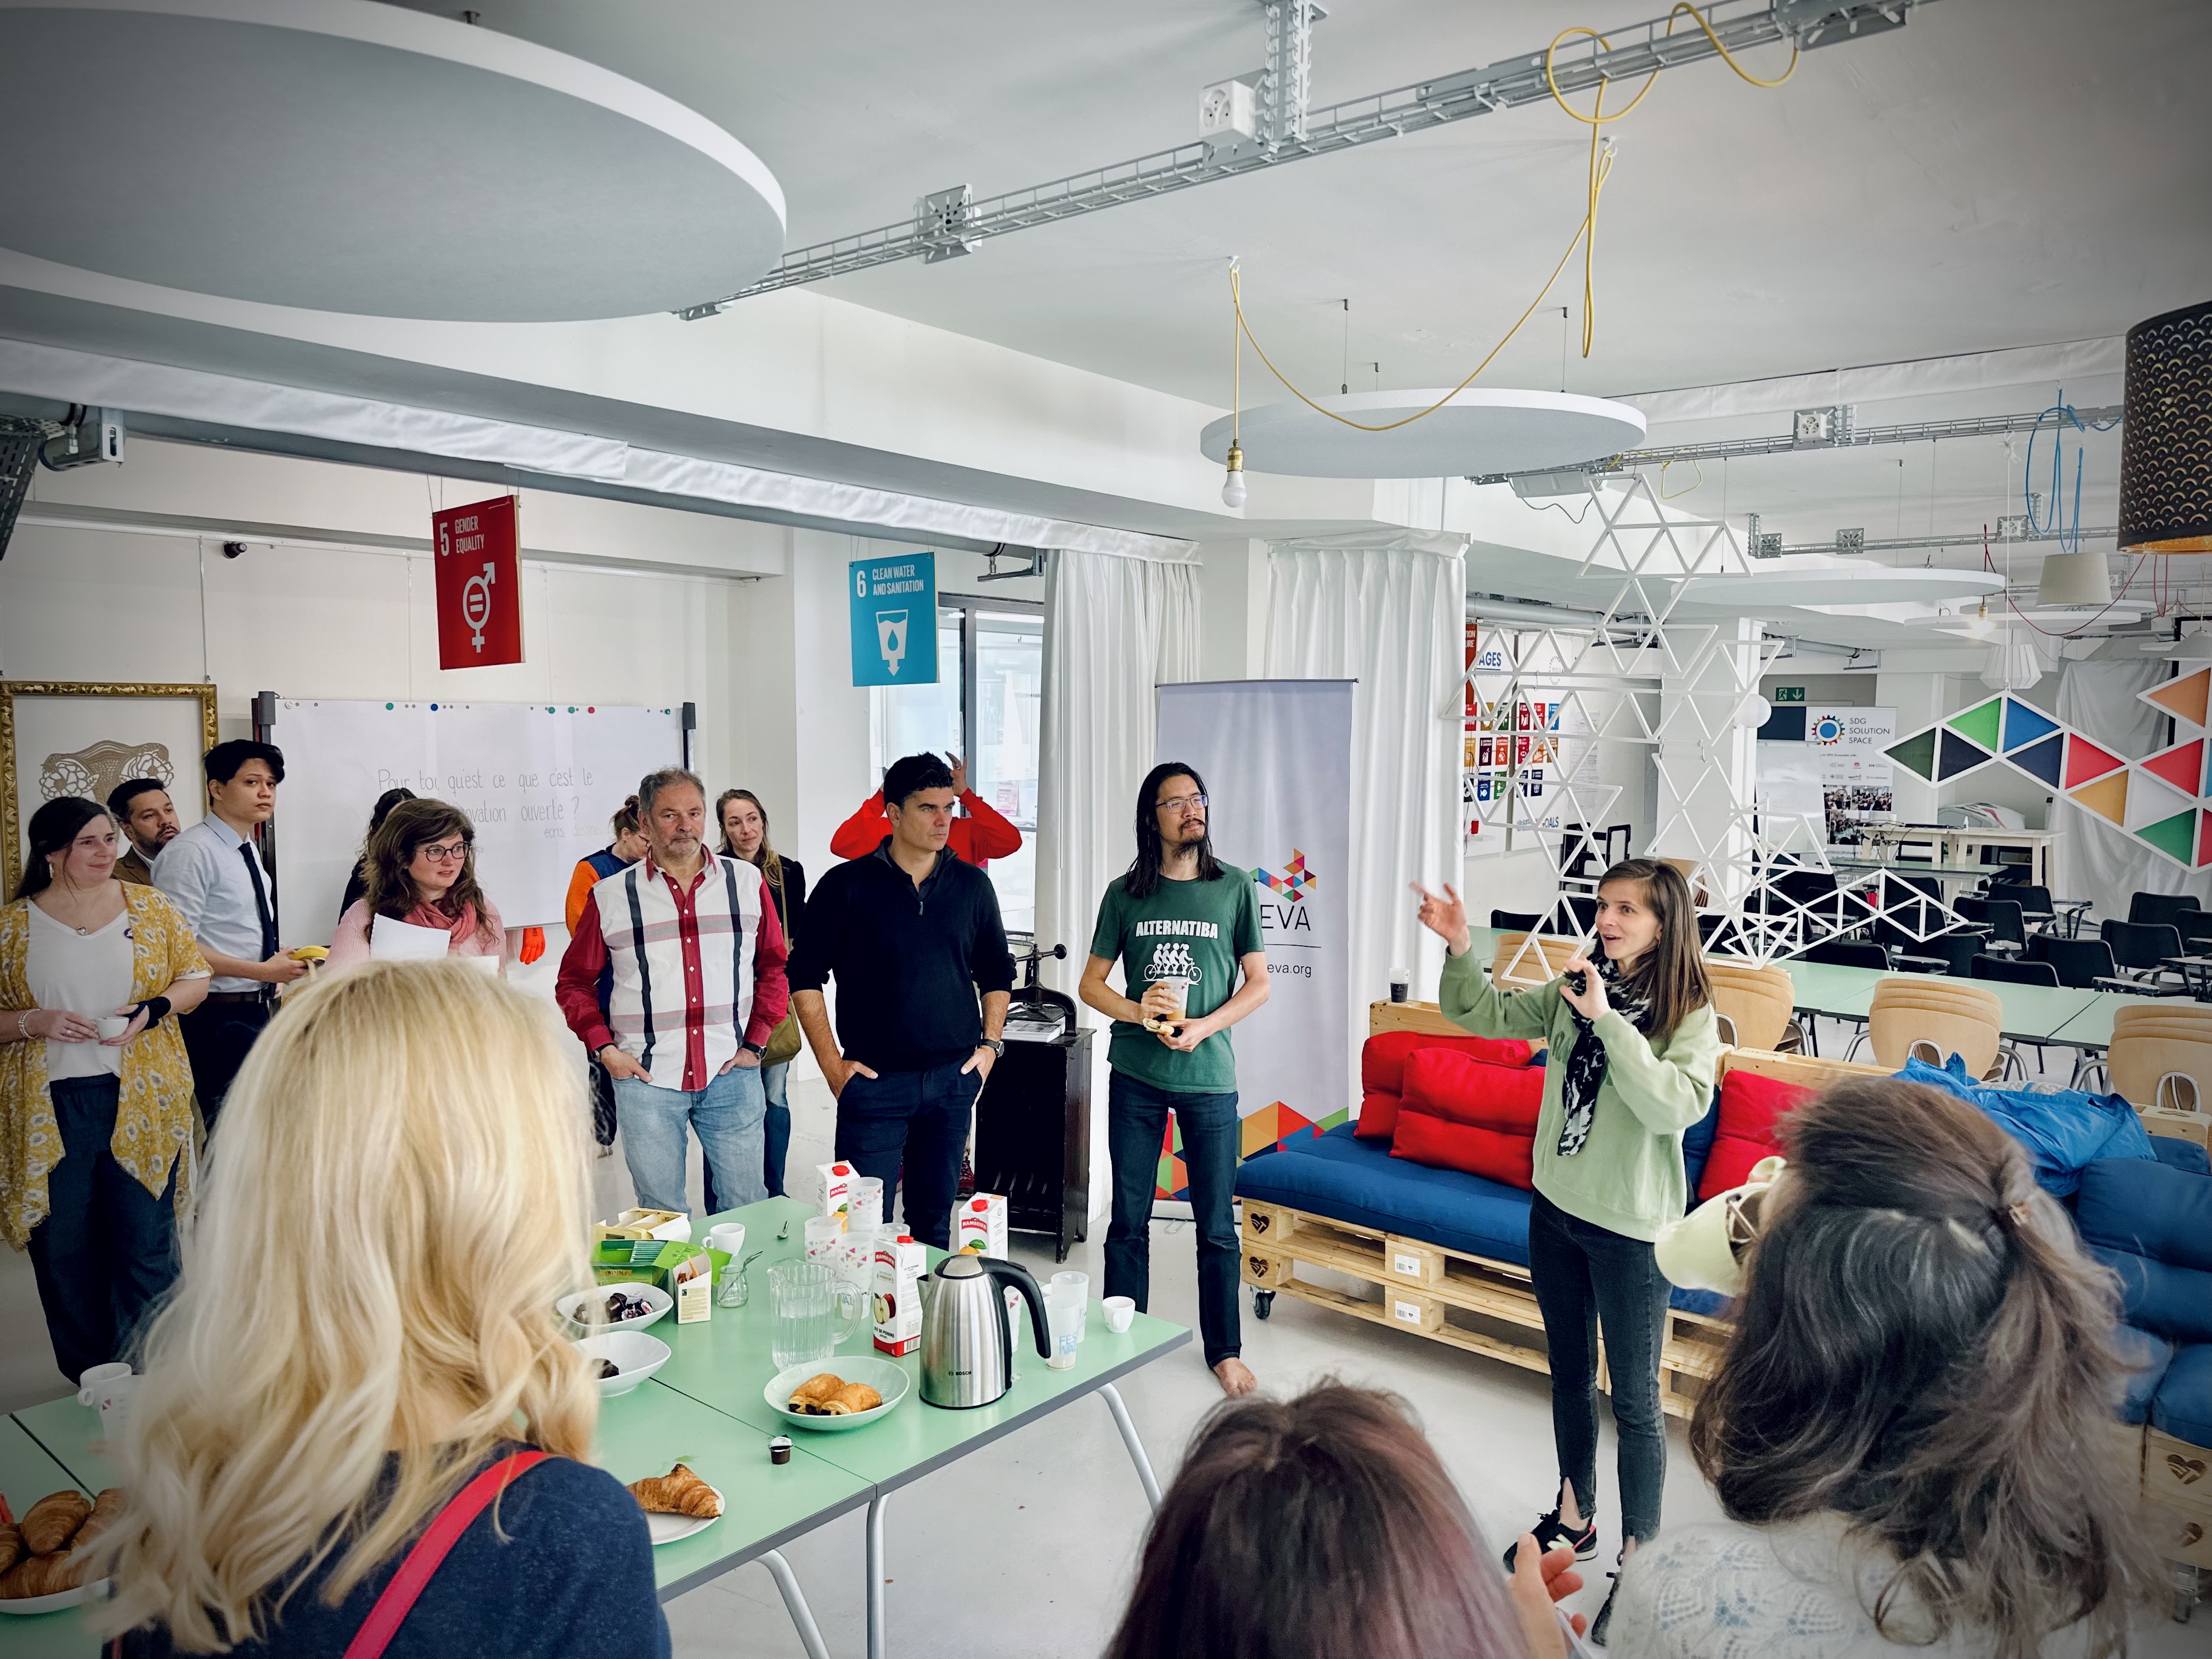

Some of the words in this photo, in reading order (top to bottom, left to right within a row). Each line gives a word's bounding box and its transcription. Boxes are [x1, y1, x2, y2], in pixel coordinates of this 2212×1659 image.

[455, 516, 478, 534] GENDER
[439, 522, 449, 556] 5
[456, 534, 484, 554] EQUALITY
[872, 567, 893, 580] CLEAN
[893, 565, 915, 578] WATER
[856, 570, 866, 598] 6
[873, 583, 886, 596] AND
[887, 579, 924, 594] SANITATION
[379, 769, 410, 791] Pour
[493, 774, 505, 788] ce
[519, 773, 539, 794] que
[549, 768, 574, 786] c'est
[583, 767, 593, 786] le
[521, 799, 564, 822] ouverte
[571, 796, 579, 819] ?
[1136, 920, 1218, 939] ALTERNATIBA
[962, 1221, 987, 1230] RAMSEIER
